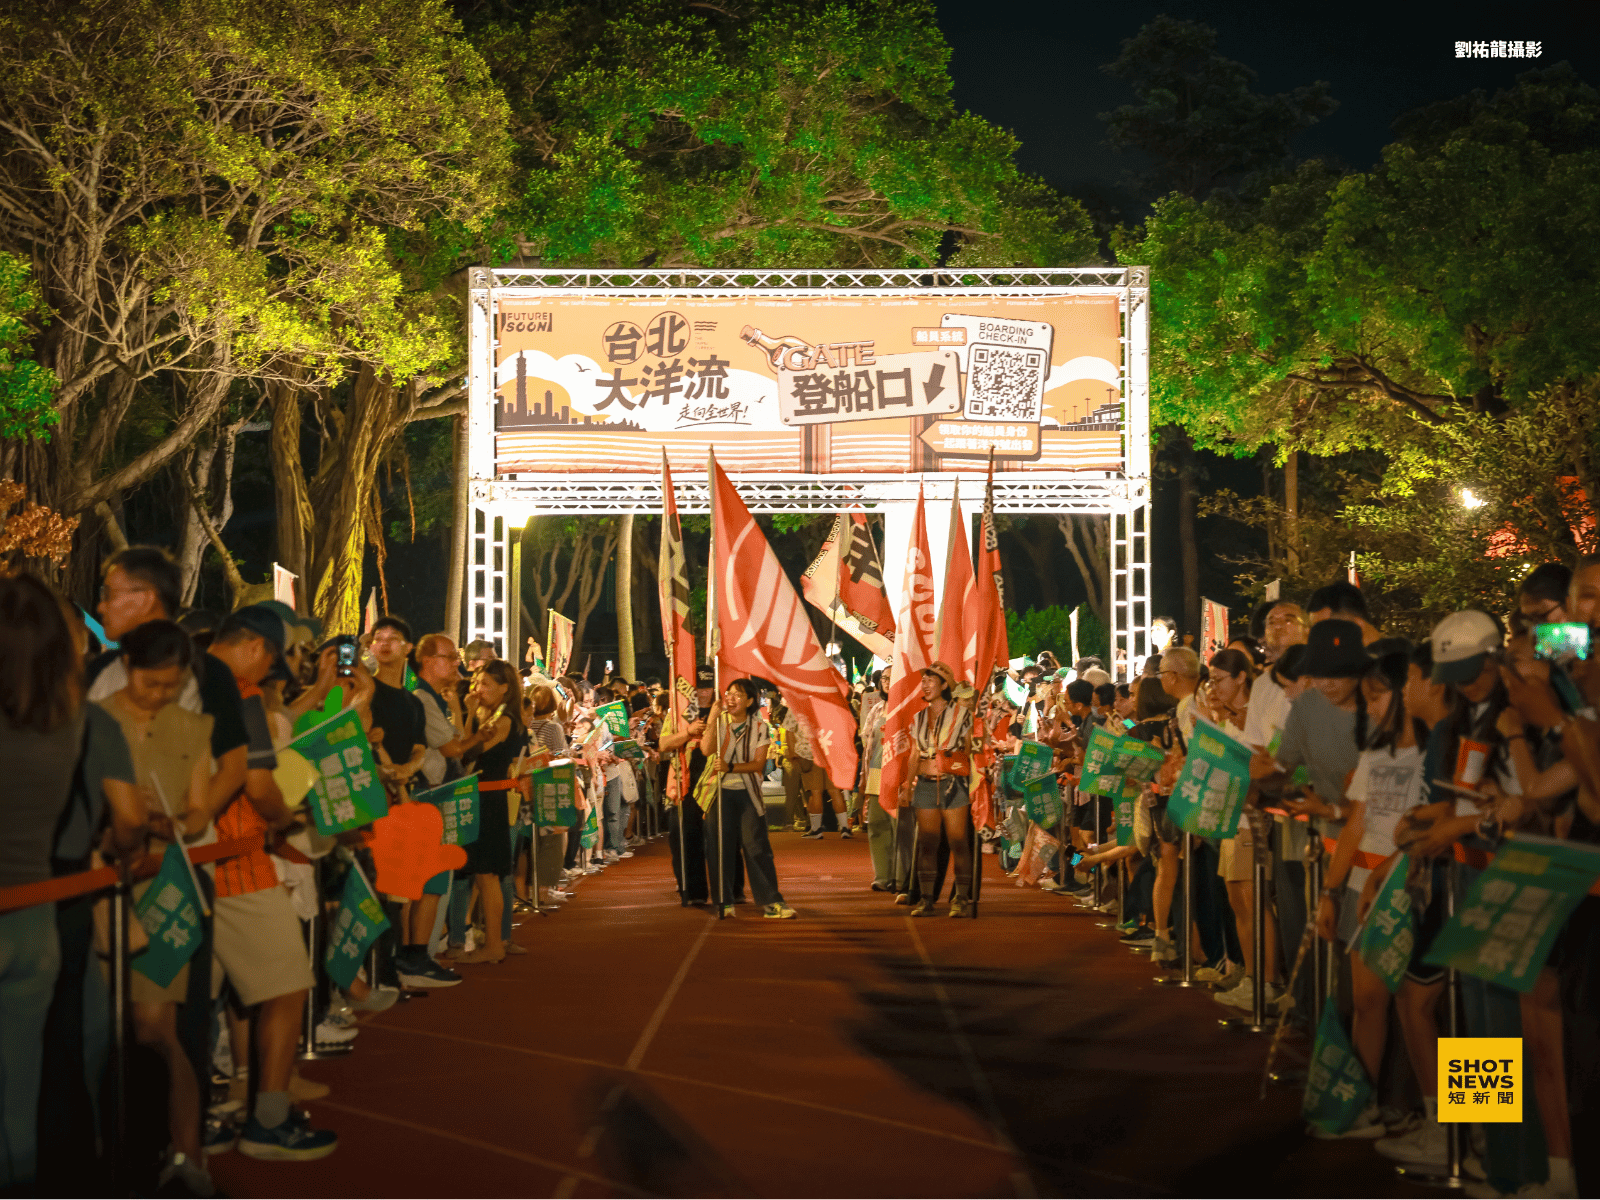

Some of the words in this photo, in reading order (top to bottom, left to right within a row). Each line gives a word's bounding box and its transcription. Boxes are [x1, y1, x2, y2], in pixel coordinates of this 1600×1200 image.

[505, 321, 547, 333] SOON
[507, 312, 548, 321] FUTURE
[605, 315, 686, 362] 台北
[979, 323, 1034, 337] BOARDING
[979, 332, 1028, 345] CHECK-IN
[783, 340, 876, 371] GATE
[593, 354, 730, 411] 大洋流
[790, 367, 914, 416] 登船口
